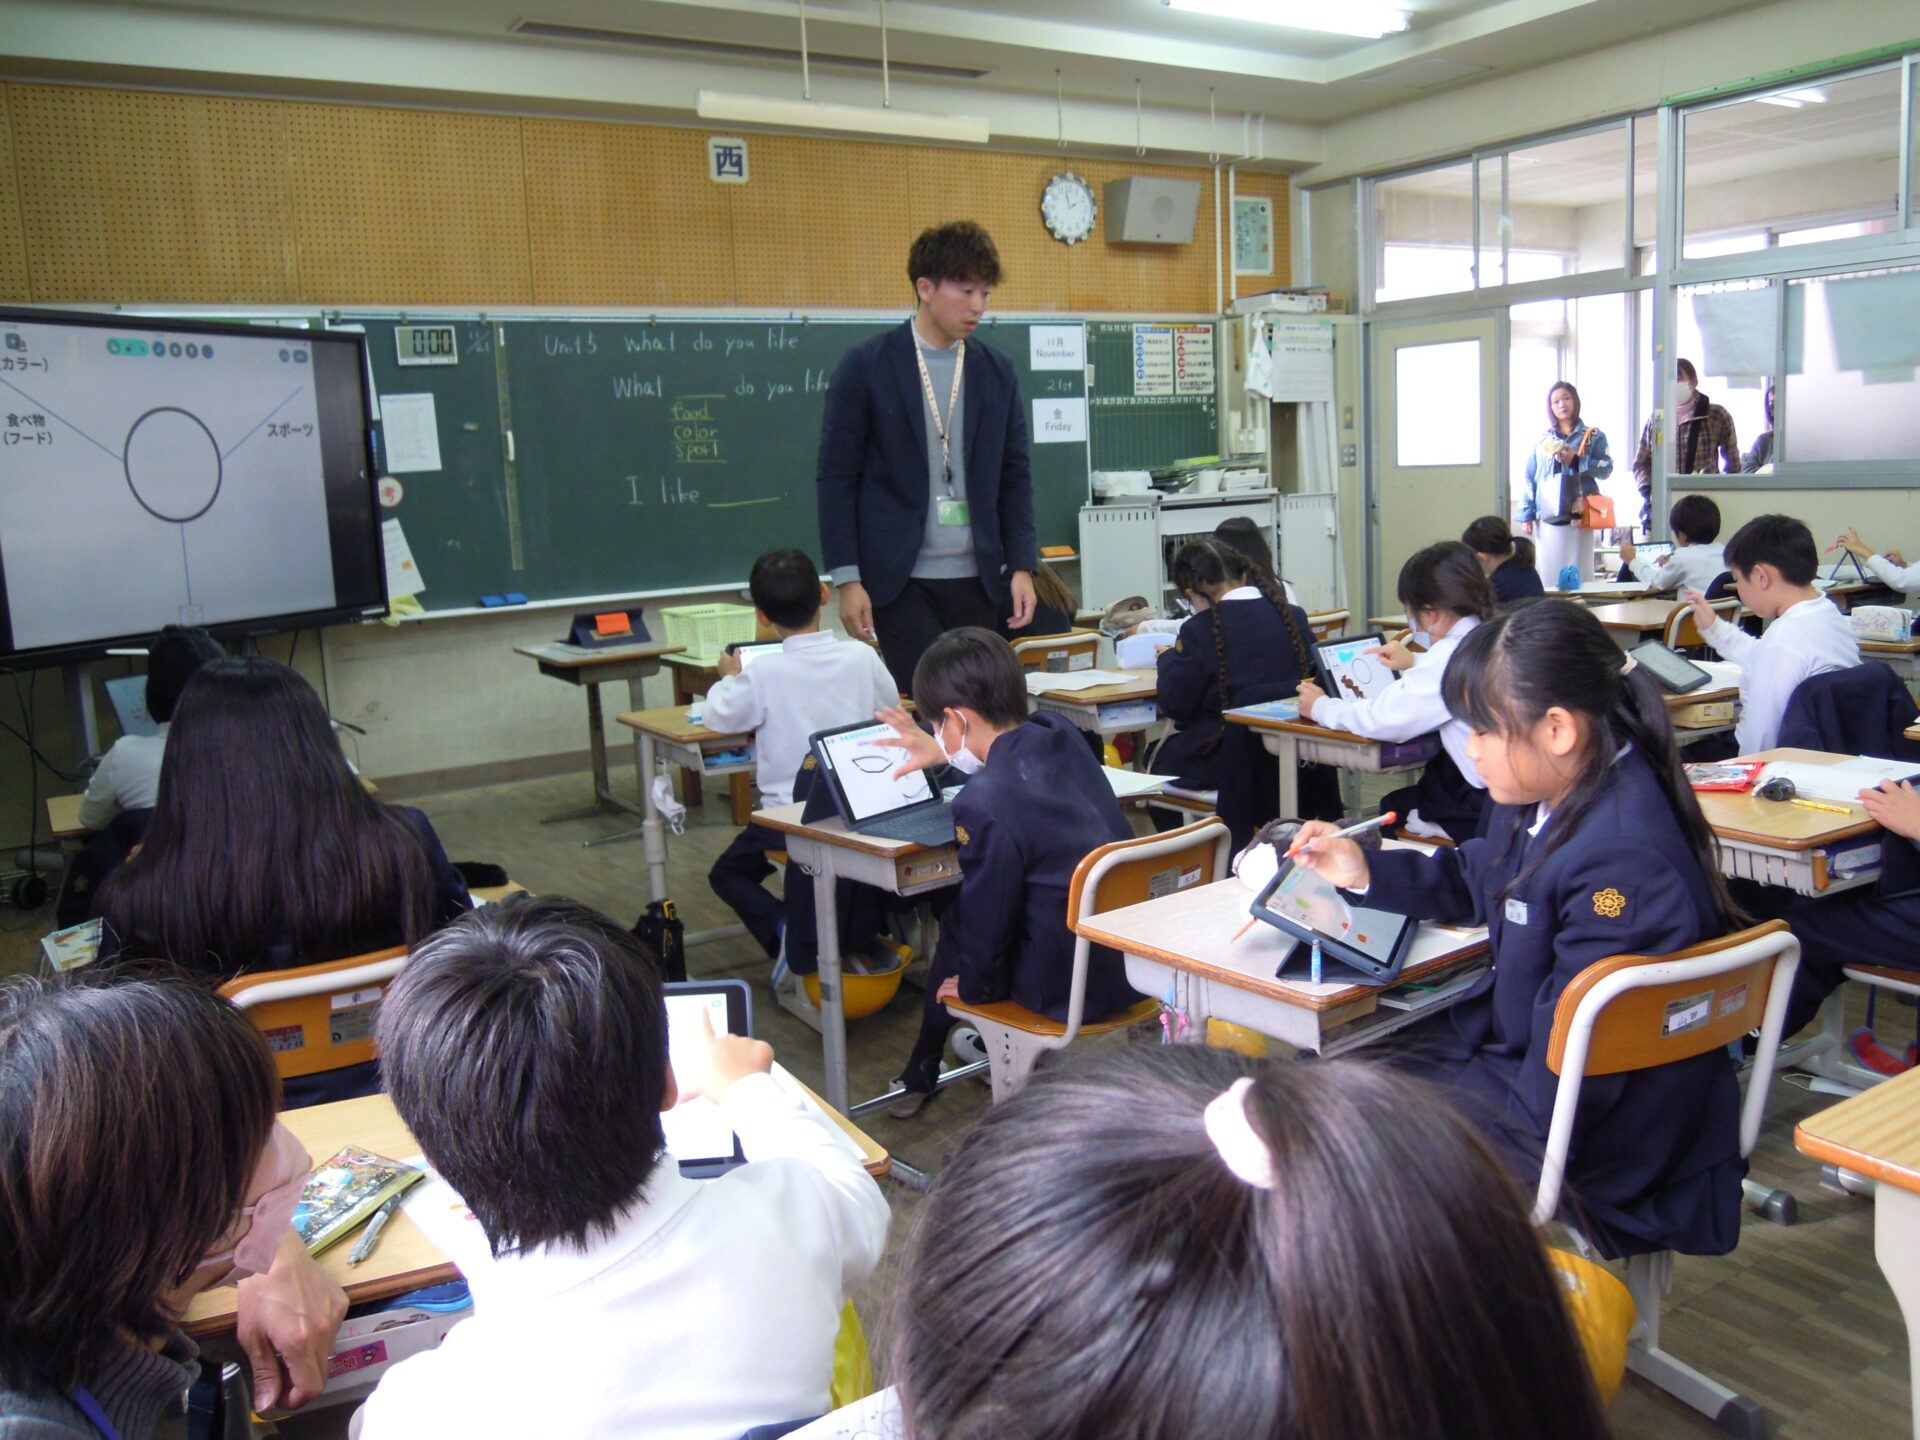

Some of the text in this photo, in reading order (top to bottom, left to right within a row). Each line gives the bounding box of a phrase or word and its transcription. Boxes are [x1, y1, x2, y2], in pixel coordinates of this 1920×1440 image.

[713, 144, 743, 176] 西
[692, 331, 713, 350] do
[725, 335, 755, 356] you
[767, 327, 799, 350] like
[1047, 337, 1064, 348] 11月
[1036, 349, 1075, 359] November
[0, 356, 49, 373] カラー)
[612, 372, 662, 398] What
[735, 374, 755, 396] do
[767, 379, 794, 400] you
[1047, 378, 1073, 392] 21st
[670, 401, 709, 420] food
[1053, 408, 1063, 420] 金
[6, 413, 46, 427] 食べ物
[267, 423, 314, 437] スポーツ
[673, 421, 719, 441] color
[1045, 422, 1072, 433] Friday
[3, 431, 53, 445] (フード)
[625, 475, 701, 505] I like
